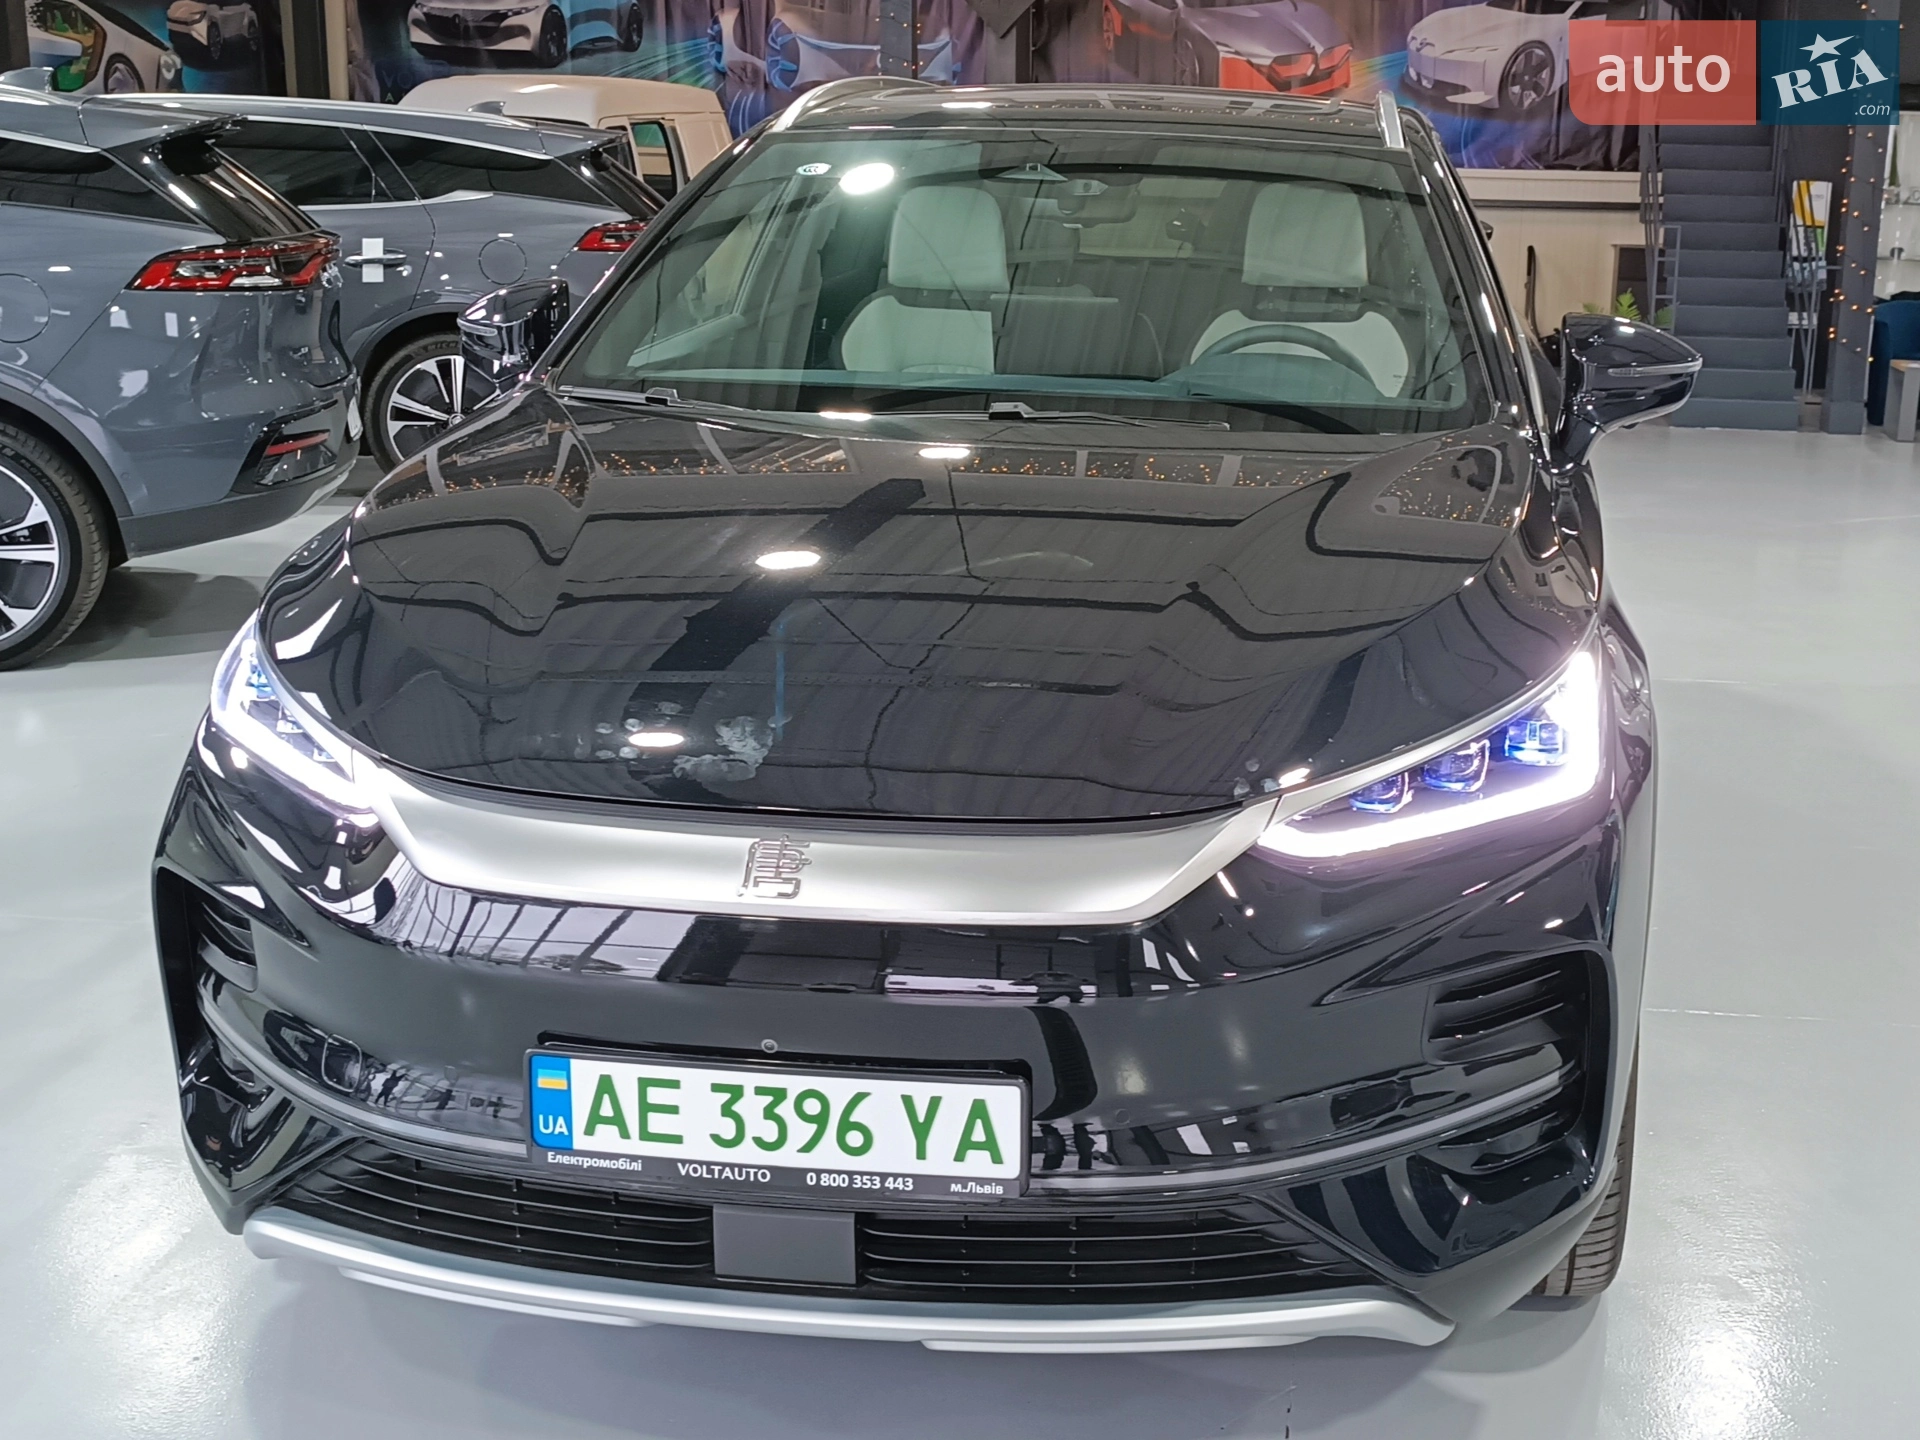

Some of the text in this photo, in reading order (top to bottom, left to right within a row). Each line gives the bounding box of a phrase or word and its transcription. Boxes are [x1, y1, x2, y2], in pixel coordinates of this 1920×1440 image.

[538, 1114, 569, 1136] UA
[584, 1074, 1004, 1165] AE 3396 YA
[547, 1151, 643, 1172] Електромобілі
[677, 1162, 771, 1183] VOLTAUTO
[806, 1172, 914, 1191] 0 800 353 443
[950, 1182, 1004, 1195] м.Львів
